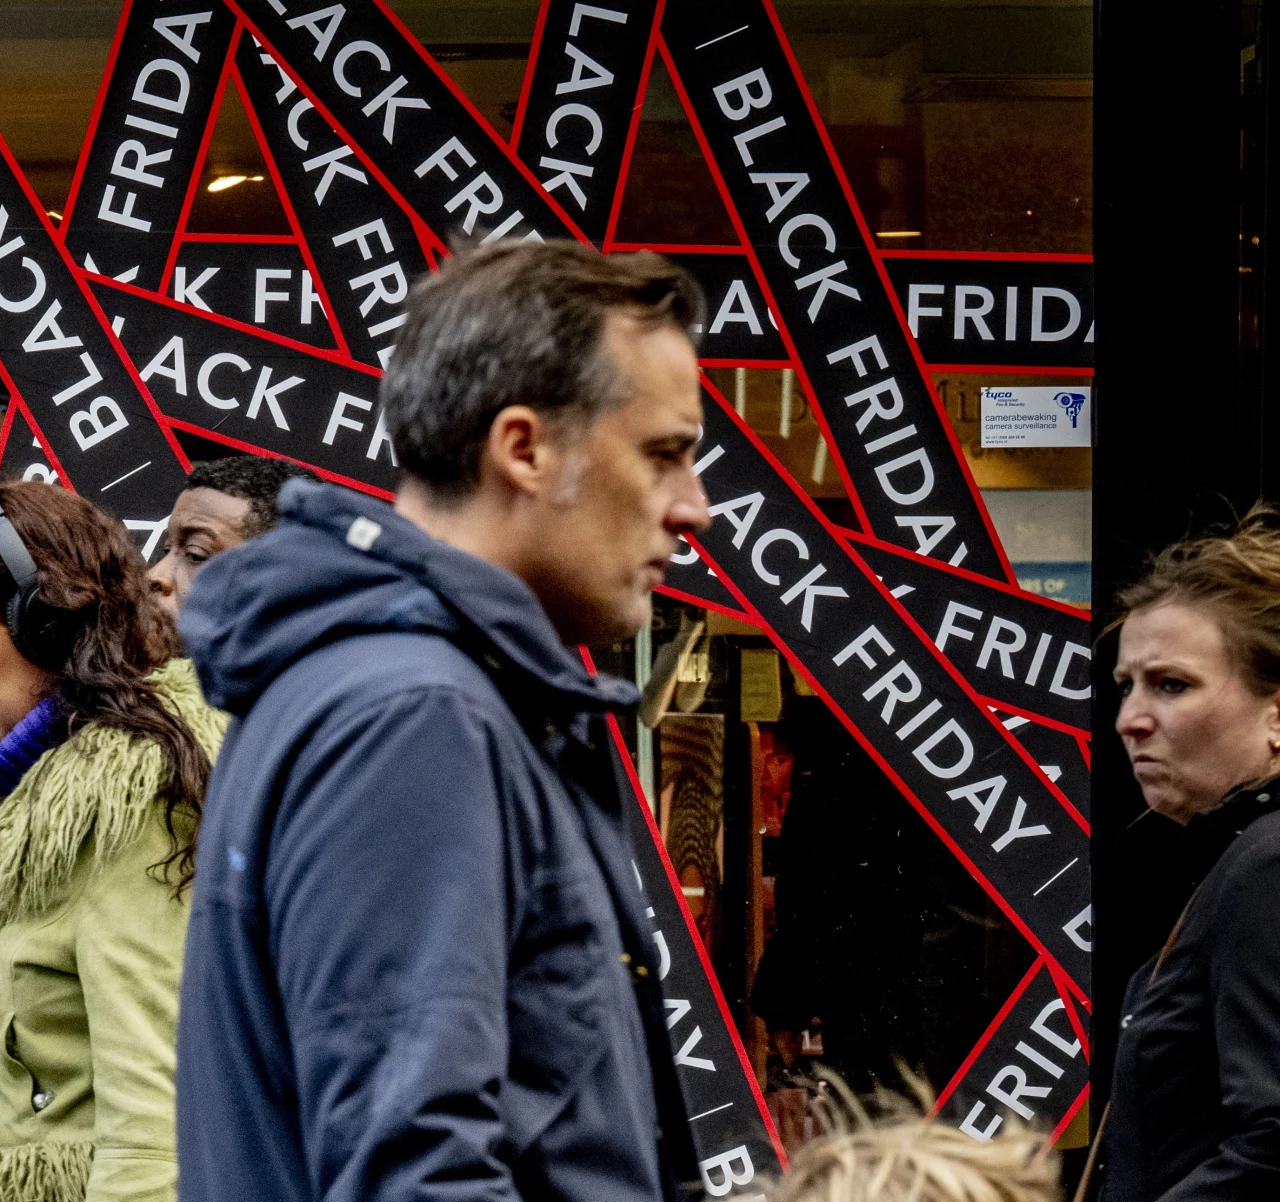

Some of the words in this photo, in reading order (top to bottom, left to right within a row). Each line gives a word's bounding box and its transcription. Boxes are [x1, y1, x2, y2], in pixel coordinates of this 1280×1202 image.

[97, 10, 212, 233] FRIDA
[271, 0, 430, 145] ACK
[540, 3, 628, 211] LACK
[112, 317, 305, 431] ACK
[712, 67, 861, 324] BLACK
[826, 334, 971, 569] FRIDA
[907, 283, 1094, 342] FRID
[985, 391, 1012, 400] tyco
[985, 414, 1057, 422] camerabewaking
[934, 600, 1092, 700] FRID
[832, 625, 1050, 853] FRIDAY
[959, 996, 1083, 1142] FRID
